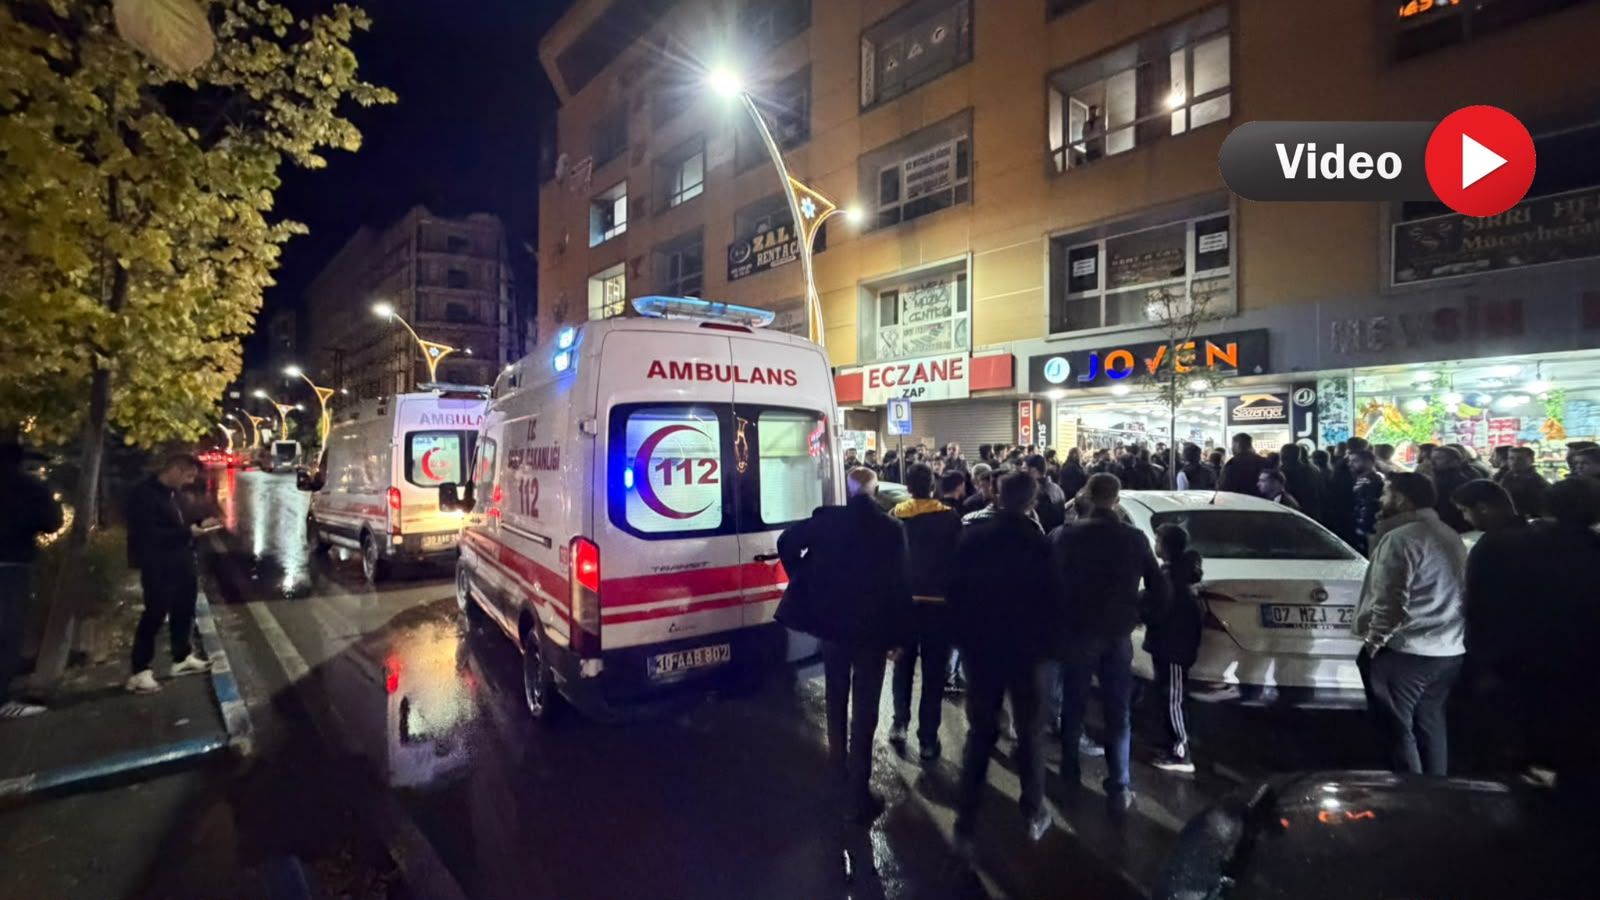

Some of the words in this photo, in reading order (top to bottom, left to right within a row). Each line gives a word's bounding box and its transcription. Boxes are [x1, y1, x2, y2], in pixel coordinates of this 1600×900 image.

[1077, 340, 1238, 382] JOVEN
[647, 360, 798, 386] AMBULANS
[869, 357, 963, 389] ECZANE
[902, 387, 925, 399] ZAP
[420, 411, 484, 426] AMBULA
[895, 404, 904, 419] D
[1232, 405, 1284, 419] Slazenger
[655, 458, 719, 486] 112
[519, 477, 539, 518] 112
[1273, 607, 1290, 622] 07
[704, 645, 729, 663] 802
